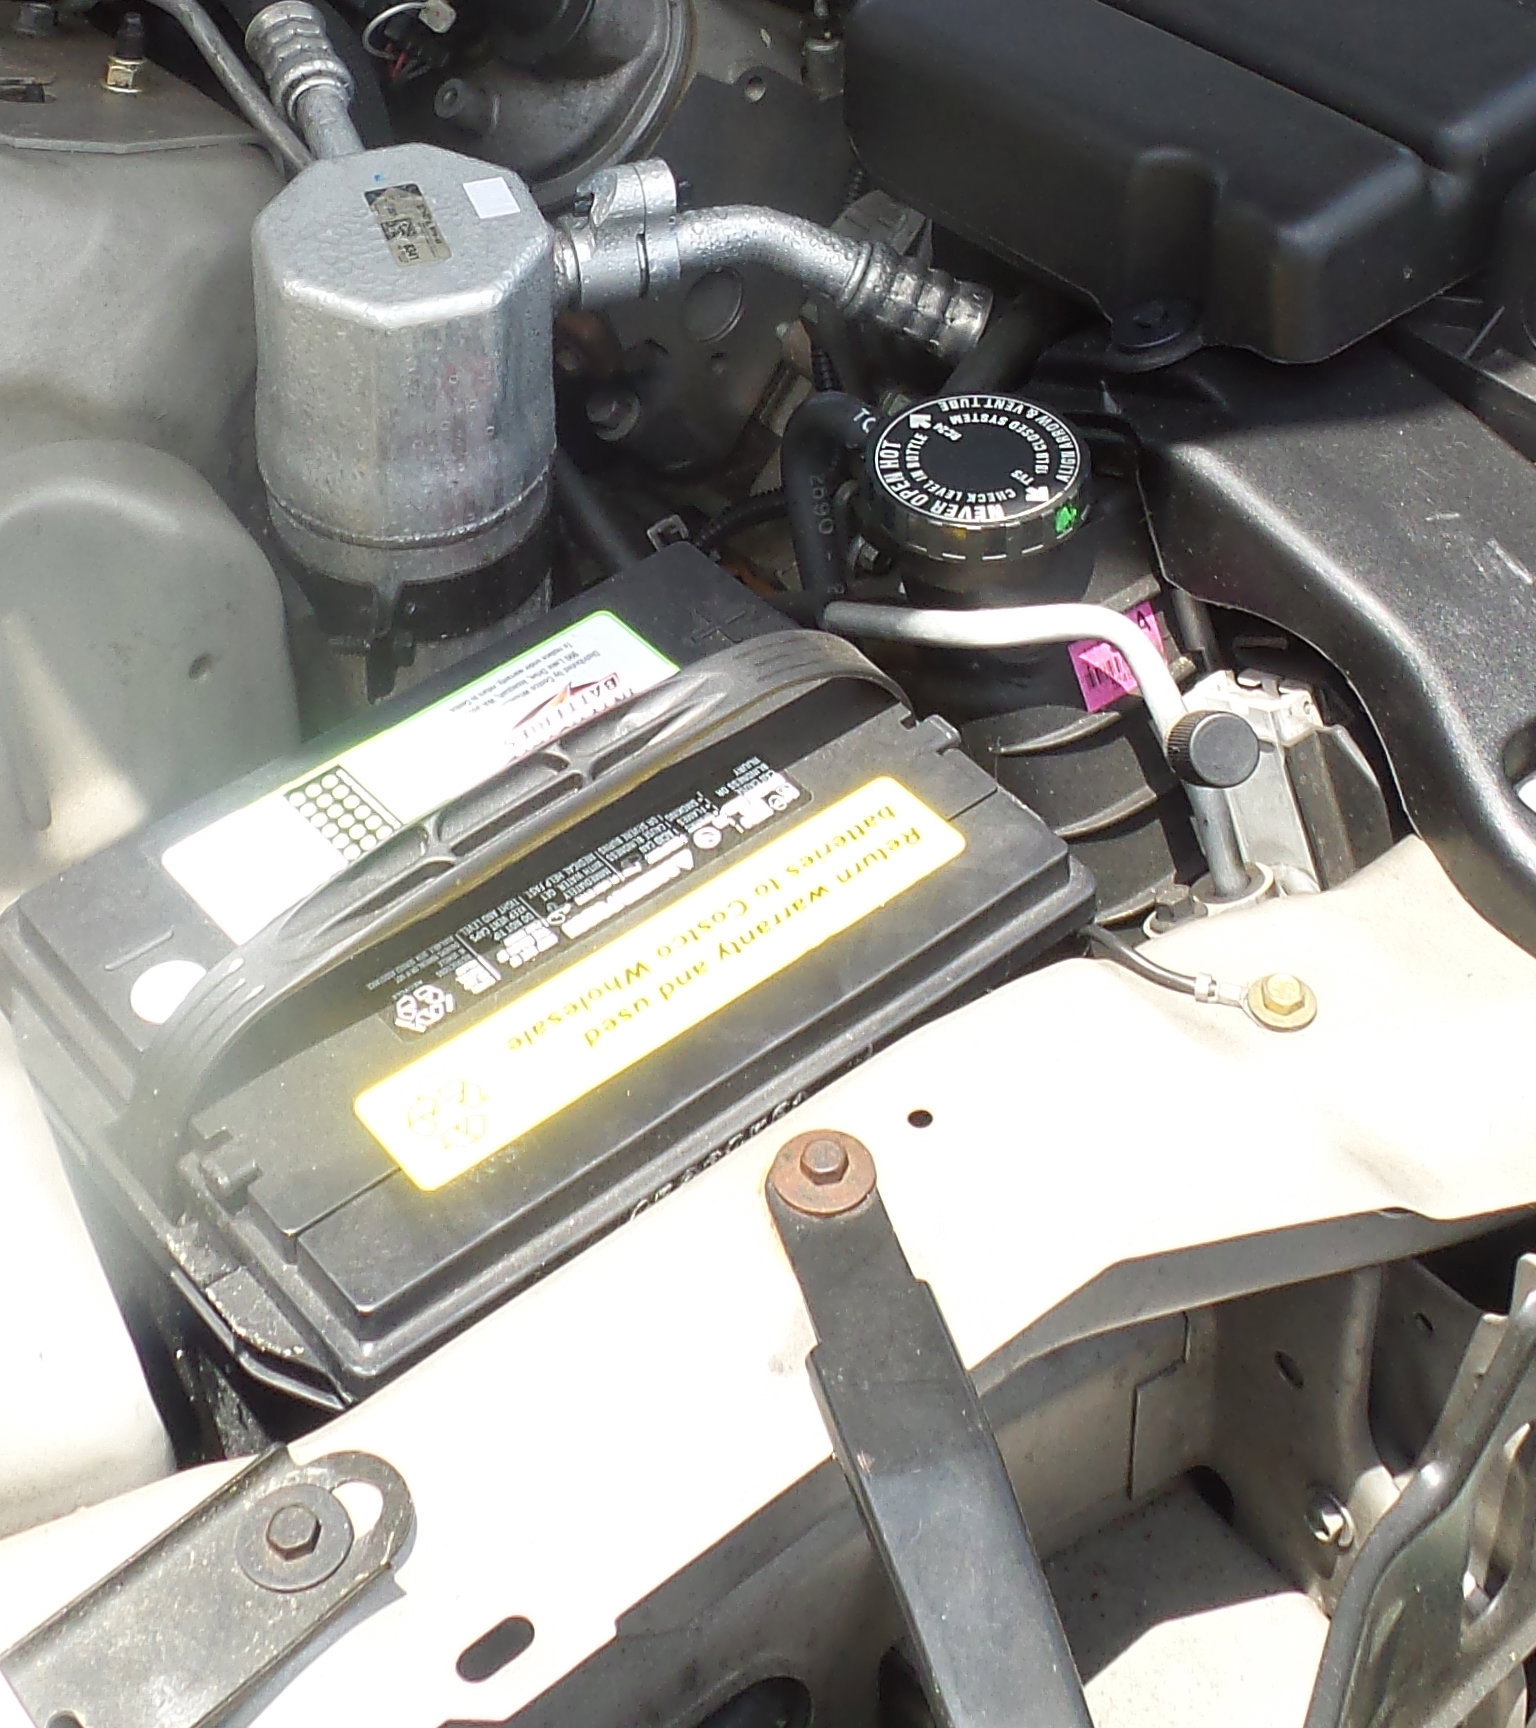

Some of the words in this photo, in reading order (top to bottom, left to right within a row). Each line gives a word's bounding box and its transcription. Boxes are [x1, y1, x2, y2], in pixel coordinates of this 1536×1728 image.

[937, 398, 987, 411] TUBE
[949, 413, 1009, 427] SYSTEM
[990, 399, 1024, 416] VENT
[905, 433, 928, 469] BOTTLE
[1008, 421, 1048, 450] CLOSED
[878, 440, 902, 470] HOT
[1056, 450, 1075, 483] ALIGN
[884, 472, 928, 506] OPEN
[922, 478, 963, 503] LEVEL
[966, 488, 1016, 505] CHECK
[931, 501, 1005, 521] NEVER
[785, 808, 896, 878] batteries
[834, 828, 921, 885] Return
[752, 877, 781, 899] to
[654, 899, 748, 960] Costco
[713, 884, 829, 960] warranty
[656, 961, 711, 999] and
[507, 963, 648, 1052] Wholesale
[581, 997, 652, 1046] used
